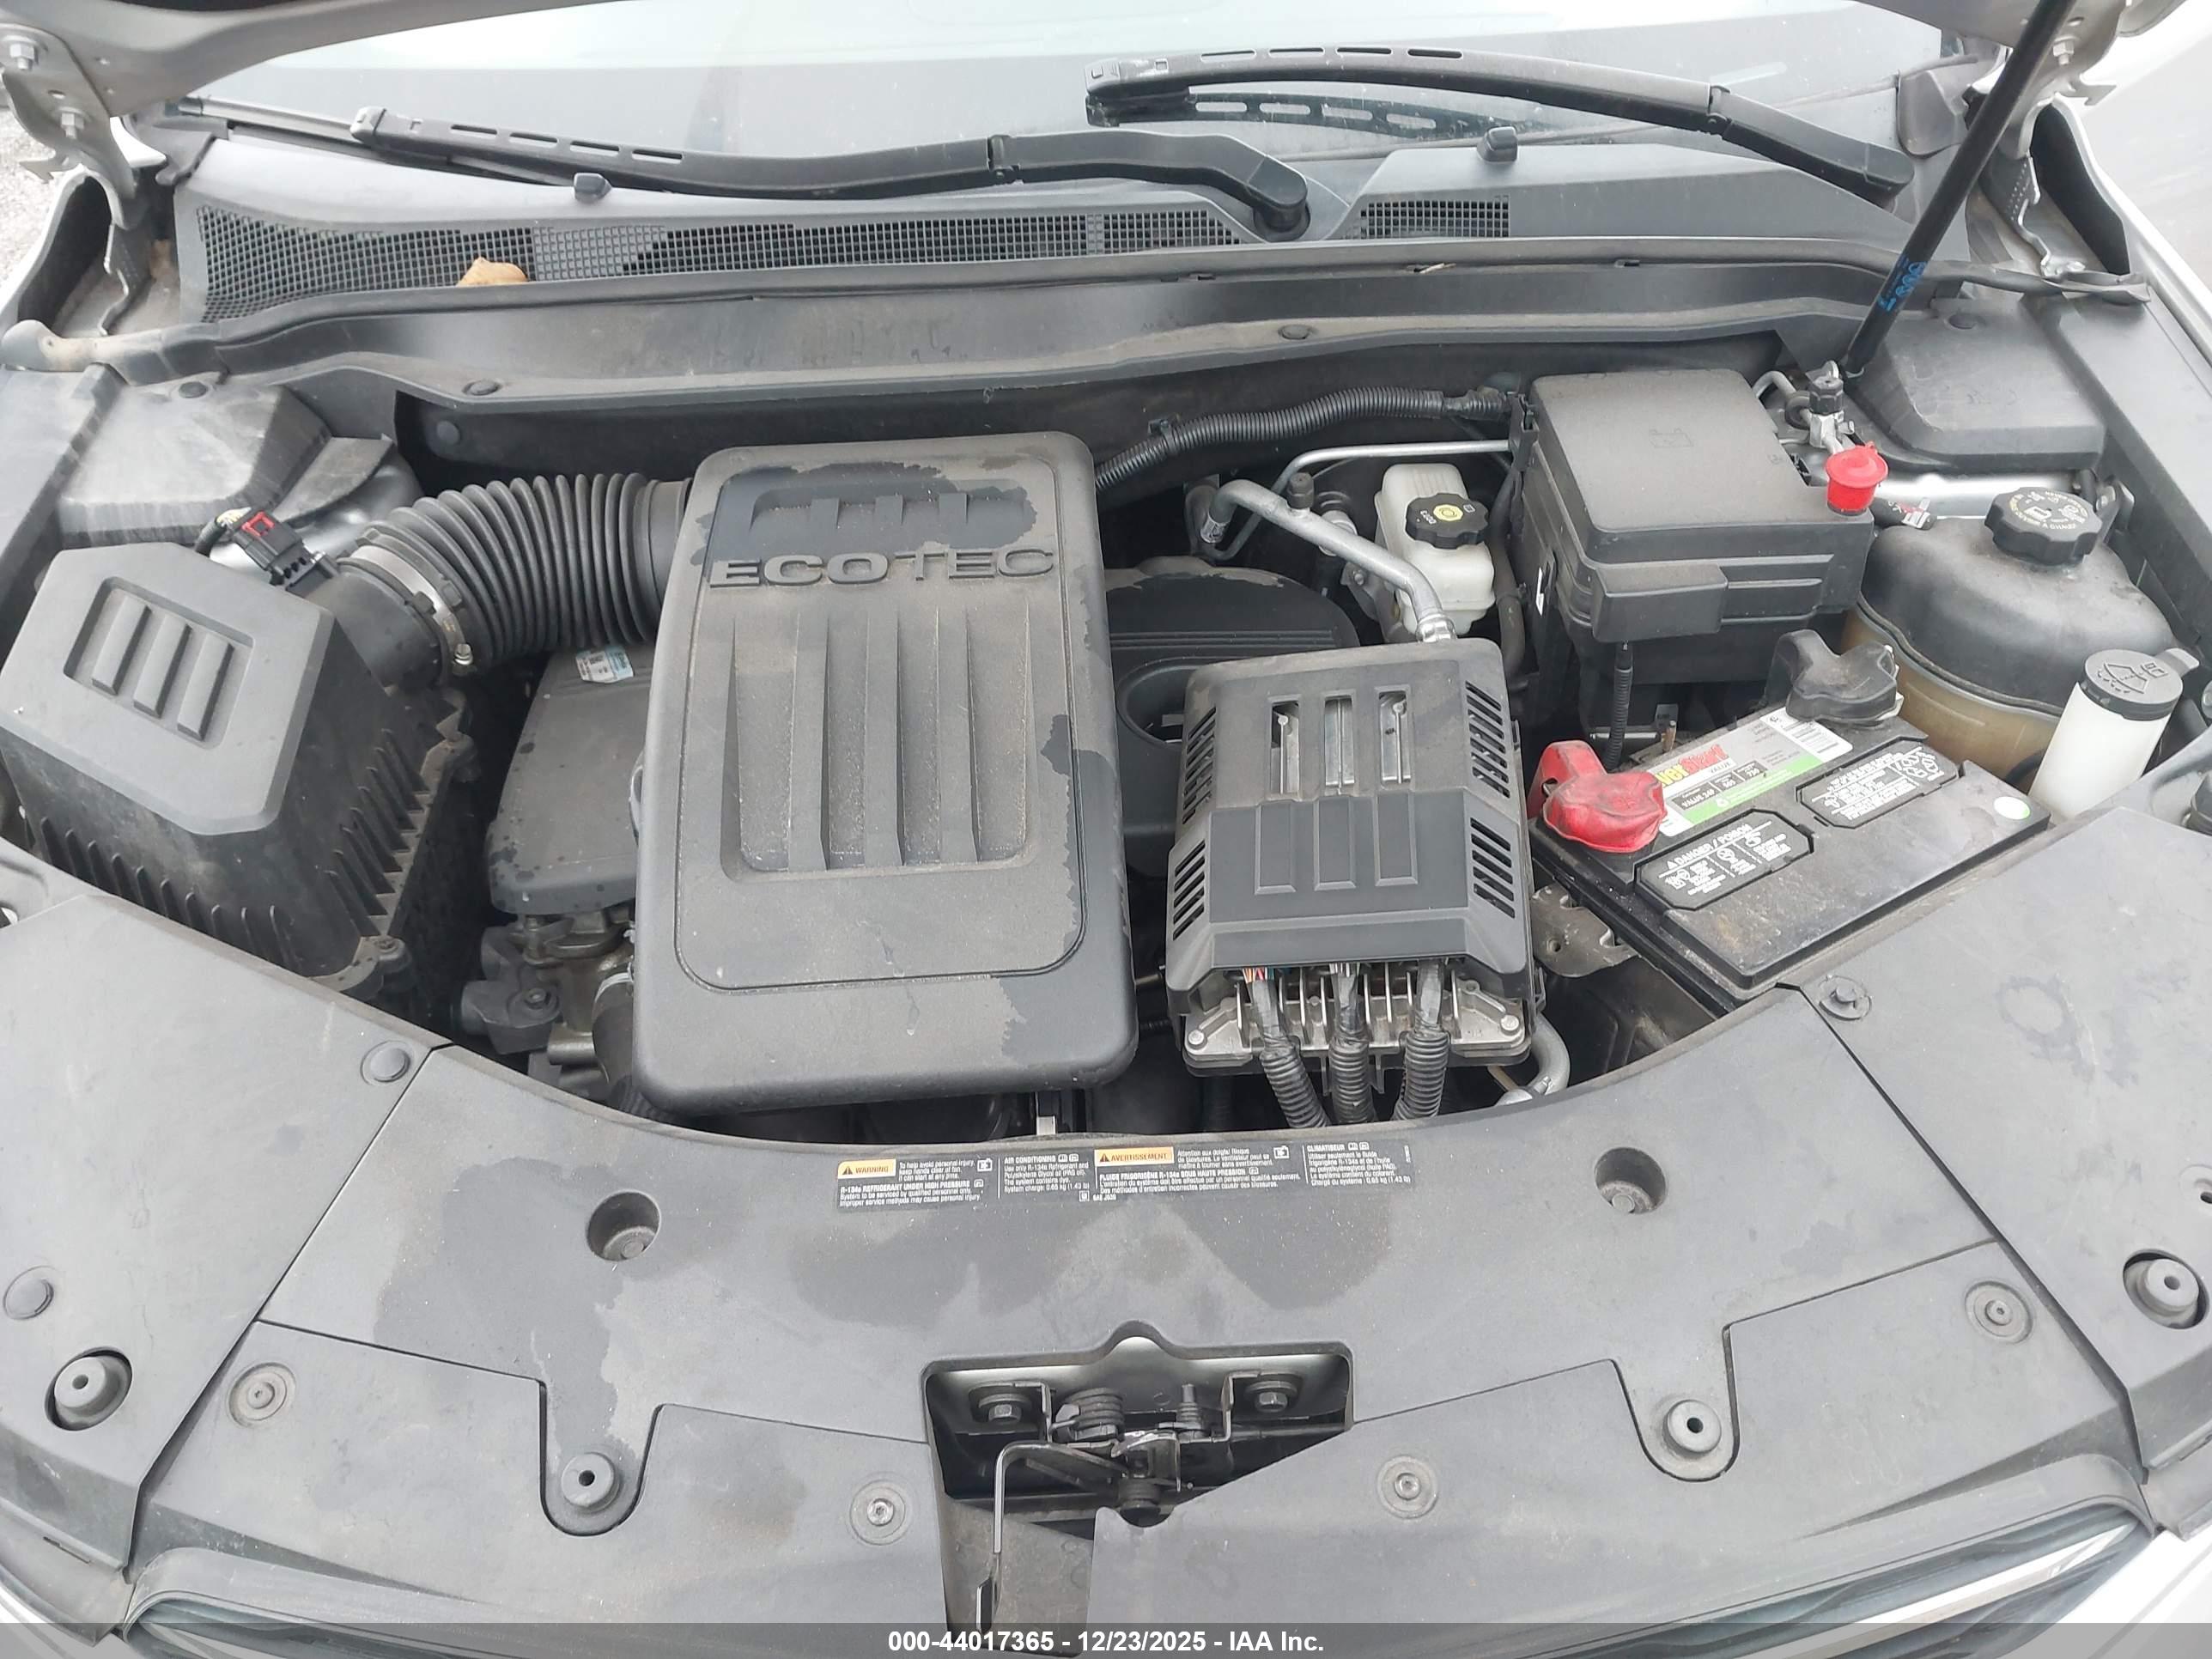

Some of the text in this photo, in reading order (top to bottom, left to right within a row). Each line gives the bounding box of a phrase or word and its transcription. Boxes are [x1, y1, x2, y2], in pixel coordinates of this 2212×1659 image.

[709, 549, 1054, 589] ECOTEC
[1674, 842, 1713, 866] DANGER
[1717, 823, 1753, 844] POISON
[1110, 1152, 1168, 1162] AVERTISSEMENT
[855, 1165, 889, 1174] WARNING
[862, 1184, 902, 1193] REFRIGERANT
